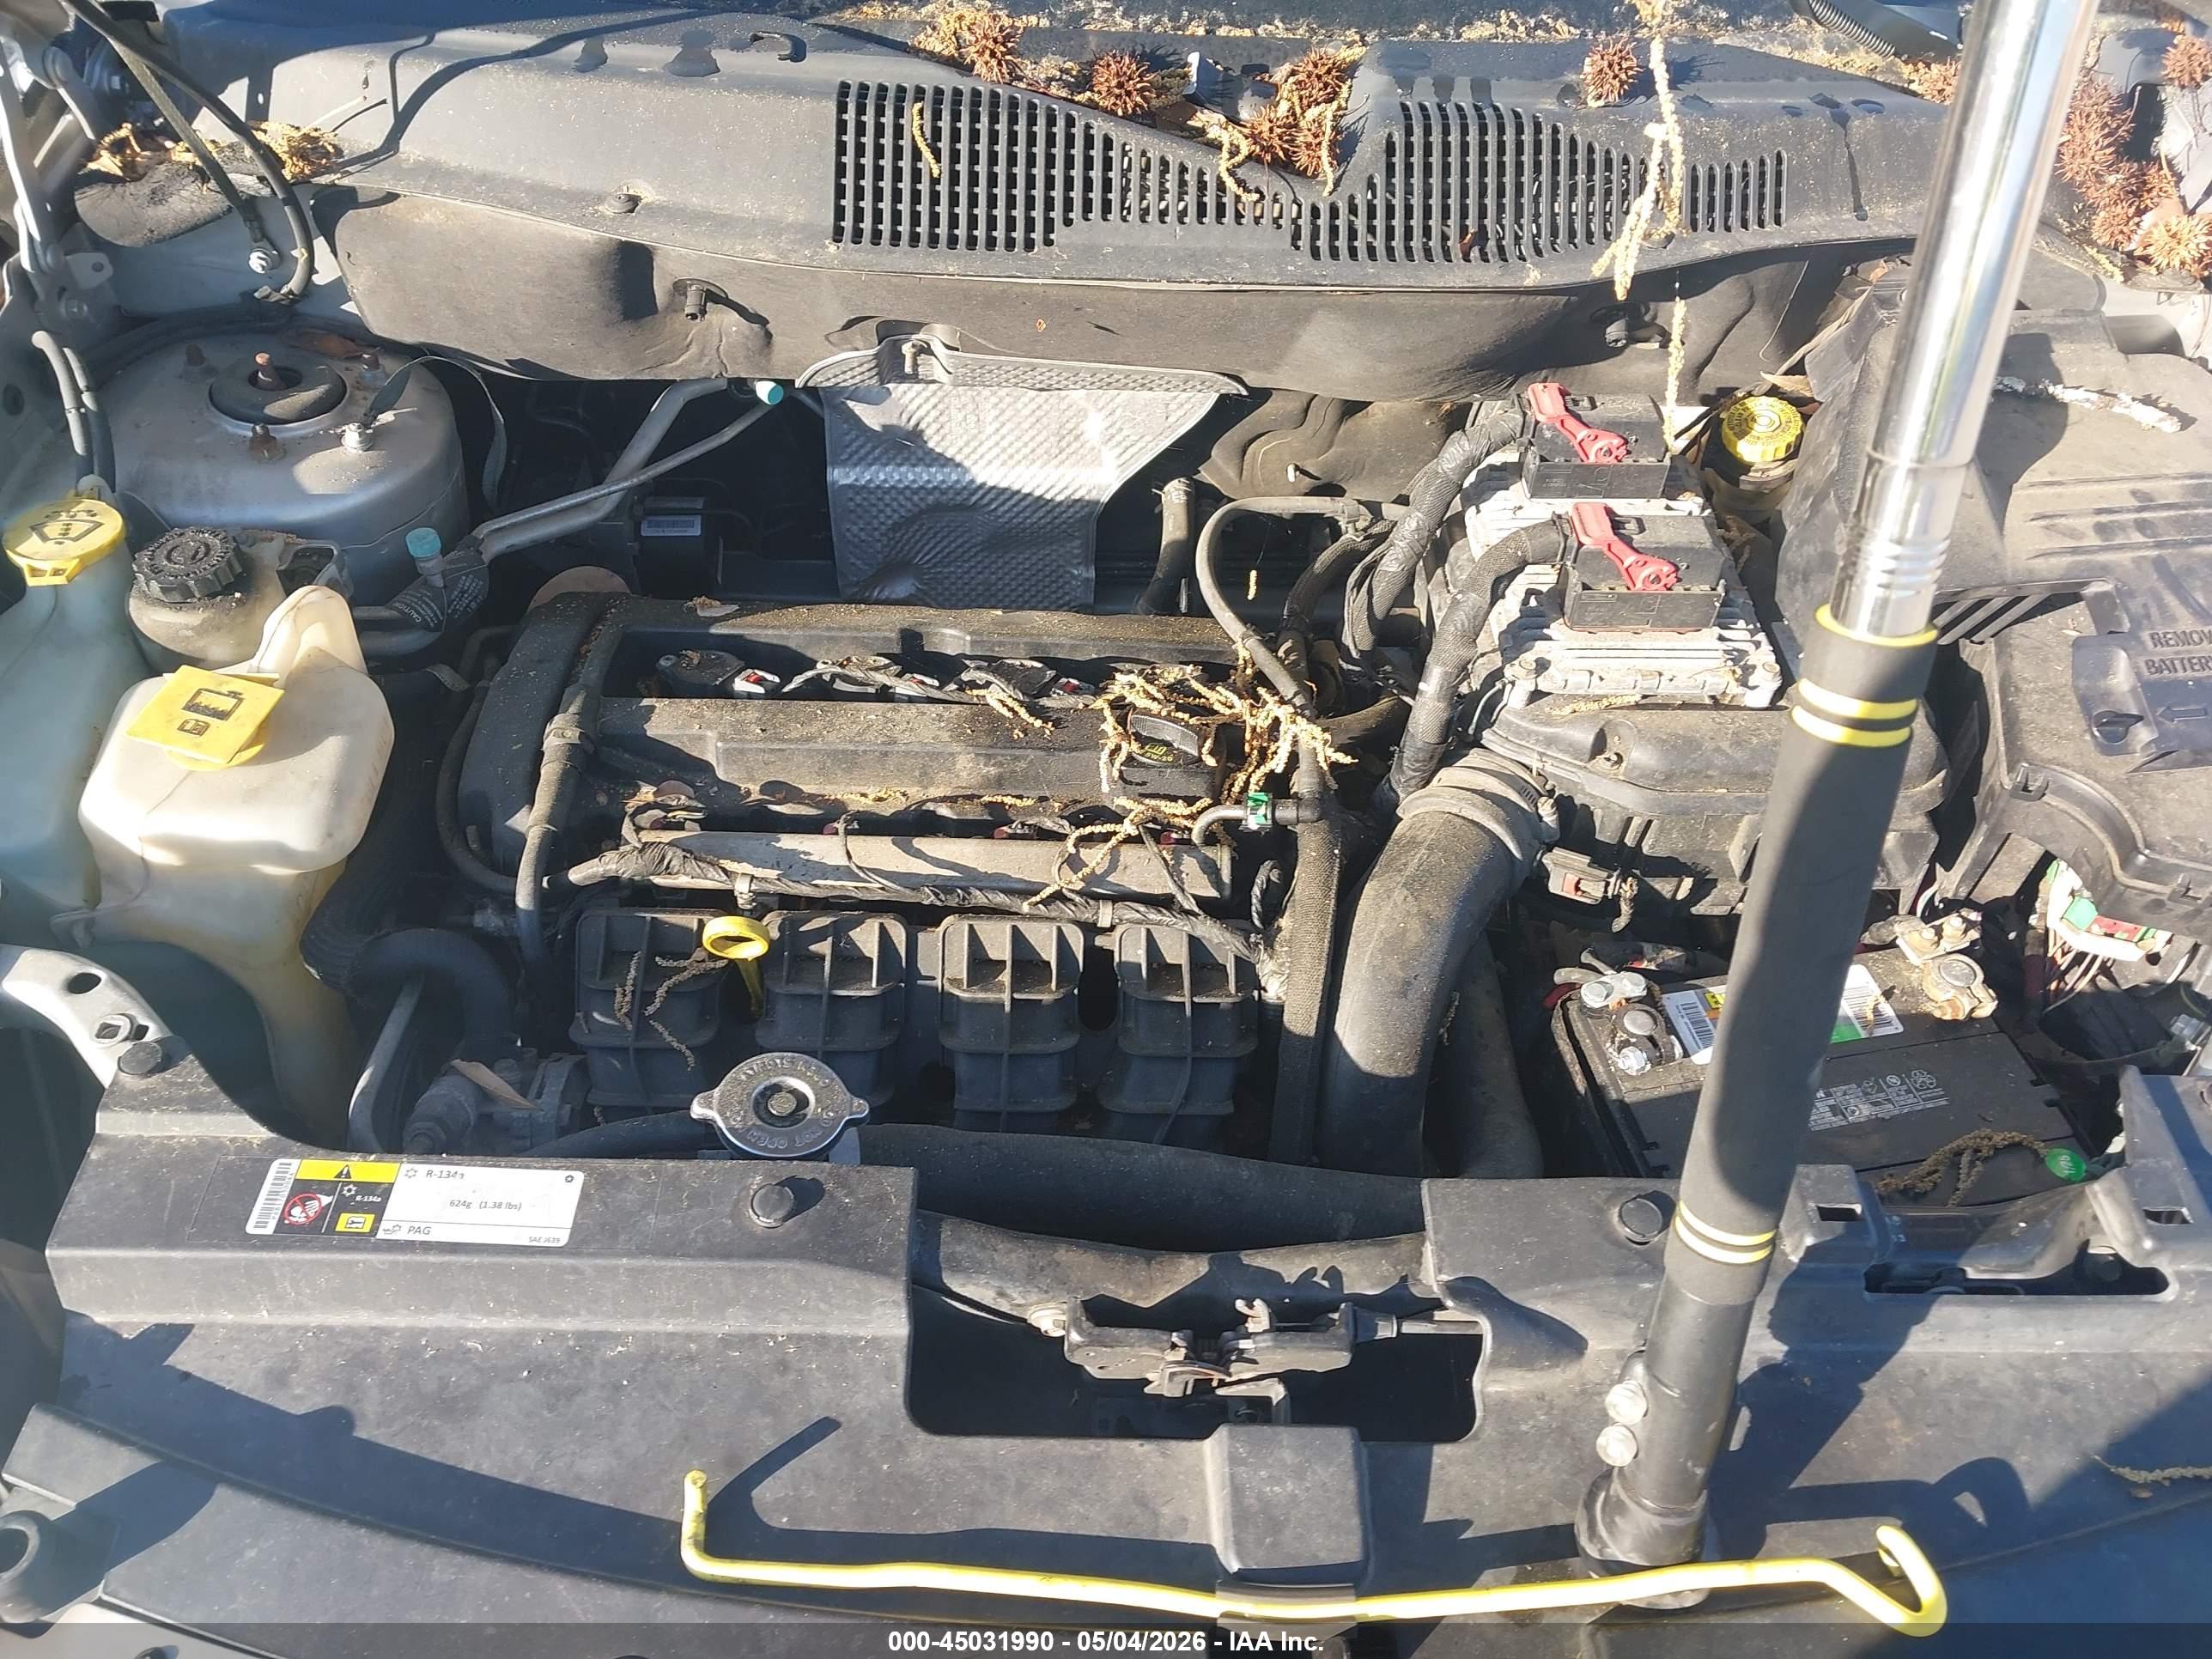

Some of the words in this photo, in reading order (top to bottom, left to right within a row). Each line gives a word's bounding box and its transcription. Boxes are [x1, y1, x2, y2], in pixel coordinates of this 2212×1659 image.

[2144, 656, 2212, 675] BATTER
[1145, 752, 1175, 762] 5W-20
[449, 1200, 472, 1209] 624g
[505, 1202, 522, 1211] lbs)
[407, 1225, 432, 1235] PAG
